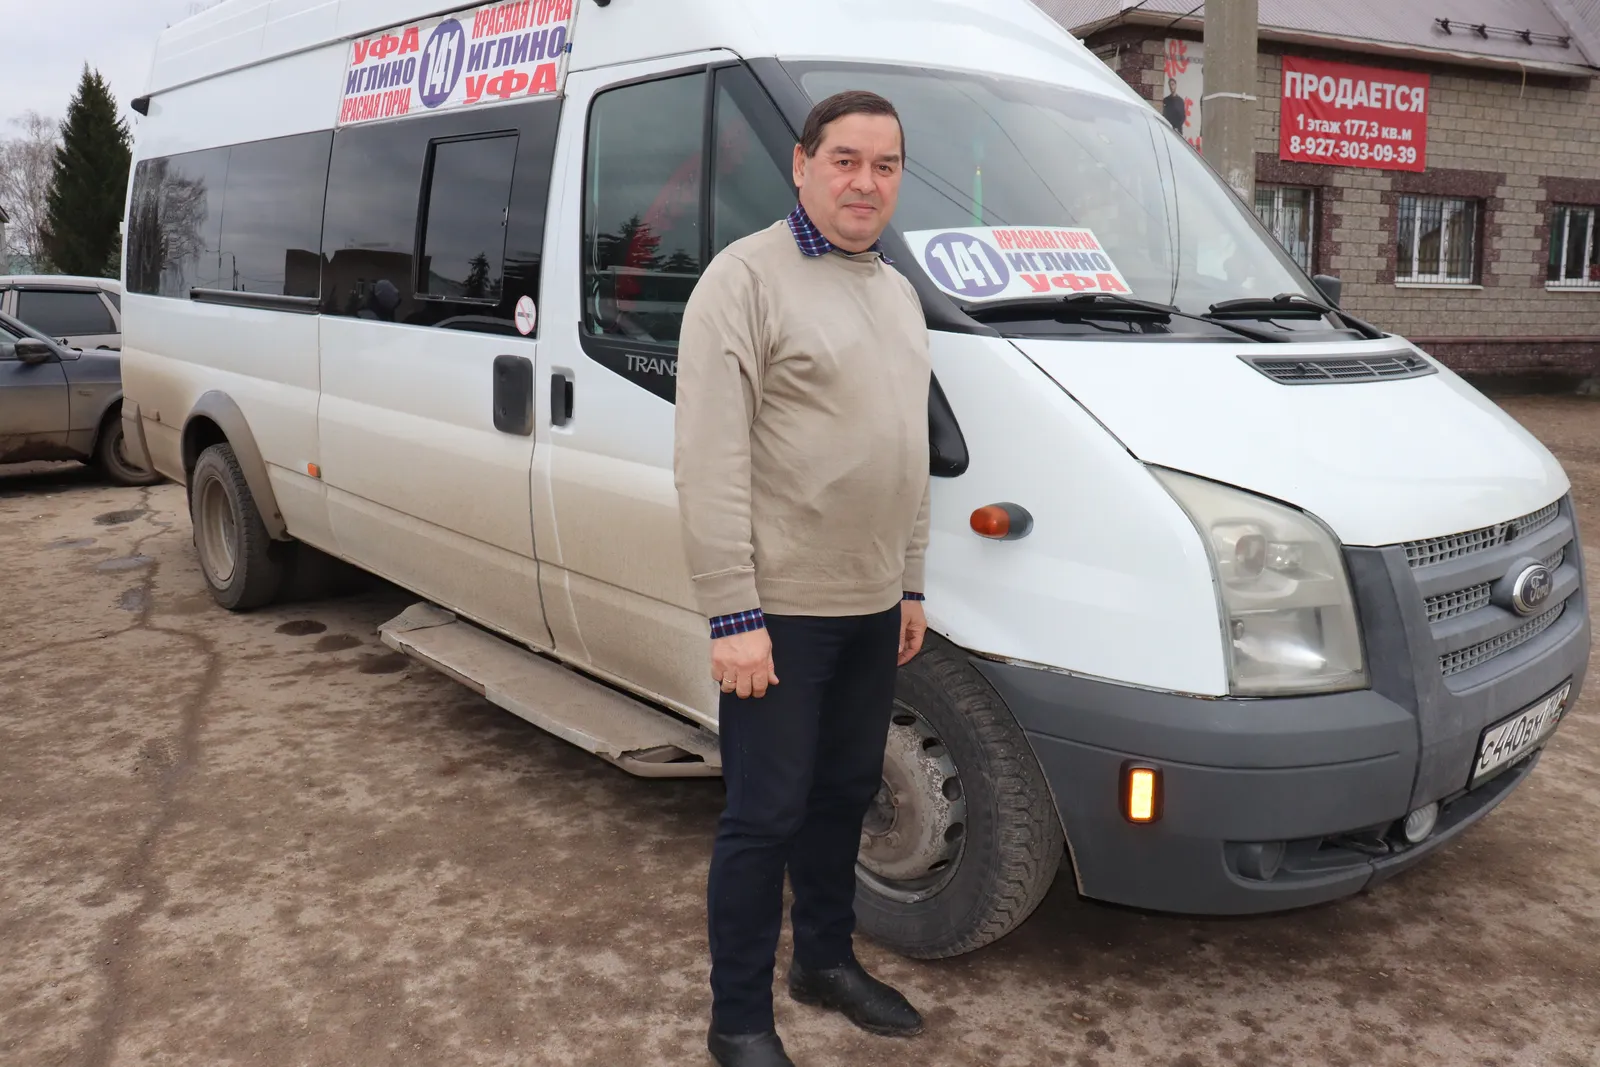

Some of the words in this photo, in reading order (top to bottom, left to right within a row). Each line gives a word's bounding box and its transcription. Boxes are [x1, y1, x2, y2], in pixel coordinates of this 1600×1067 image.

[472, 3, 527, 39] КРАСНАЯ
[353, 27, 419, 65] УФА
[425, 30, 460, 96] 141
[467, 26, 566, 72] ИГЛИНО
[346, 57, 416, 94] ИГЛИНО
[463, 63, 556, 104] УФА
[1284, 70, 1425, 113] ПРОДАЕТСЯ
[340, 93, 381, 122] КРАСНАЯ
[381, 87, 412, 116] ГОРКА
[1297, 113, 1305, 131] 1
[1307, 118, 1341, 134] этаж
[1344, 119, 1379, 139] 177,3
[1381, 126, 1412, 141] кв.м
[1289, 135, 1417, 164] 8-927-303-09-39
[992, 229, 1059, 250] КРАСНАЯ
[1055, 231, 1100, 250] ГОРКА
[931, 241, 1002, 289] 141
[1004, 252, 1112, 273] ИГЛИНО
[1019, 273, 1128, 293] УФА
